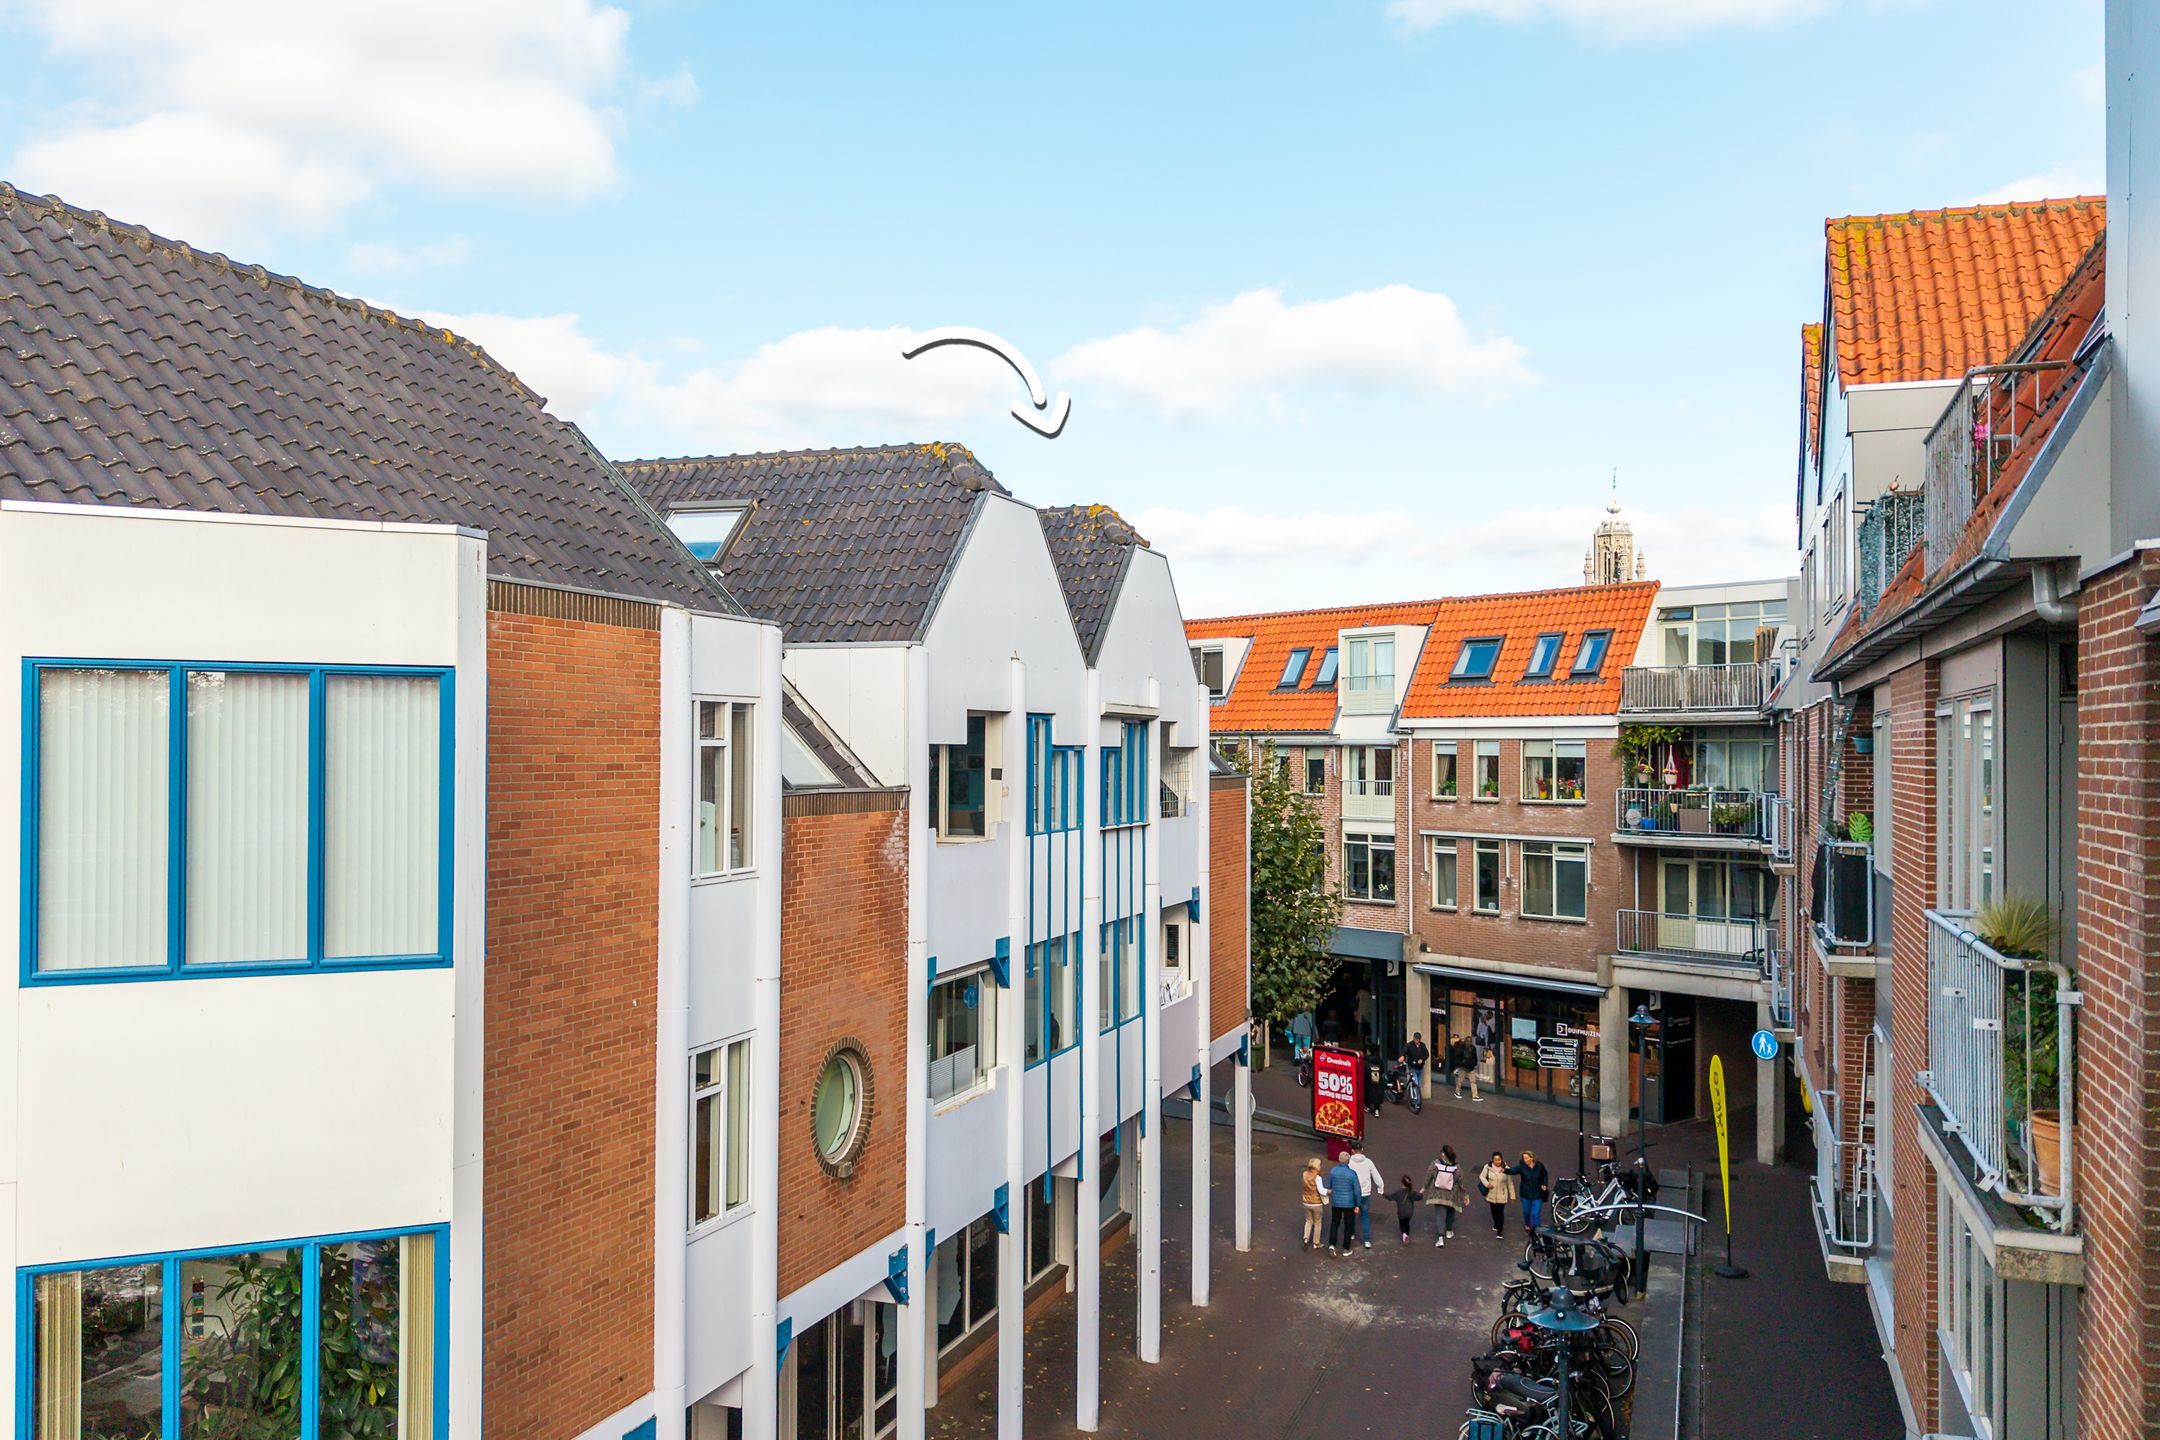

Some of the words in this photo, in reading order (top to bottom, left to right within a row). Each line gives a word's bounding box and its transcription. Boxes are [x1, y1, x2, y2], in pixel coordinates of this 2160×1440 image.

[1567, 1027, 1600, 1037] DUIFHUIZEN
[1326, 1057, 1351, 1067] Domino's
[1318, 1071, 1353, 1095] 50%
